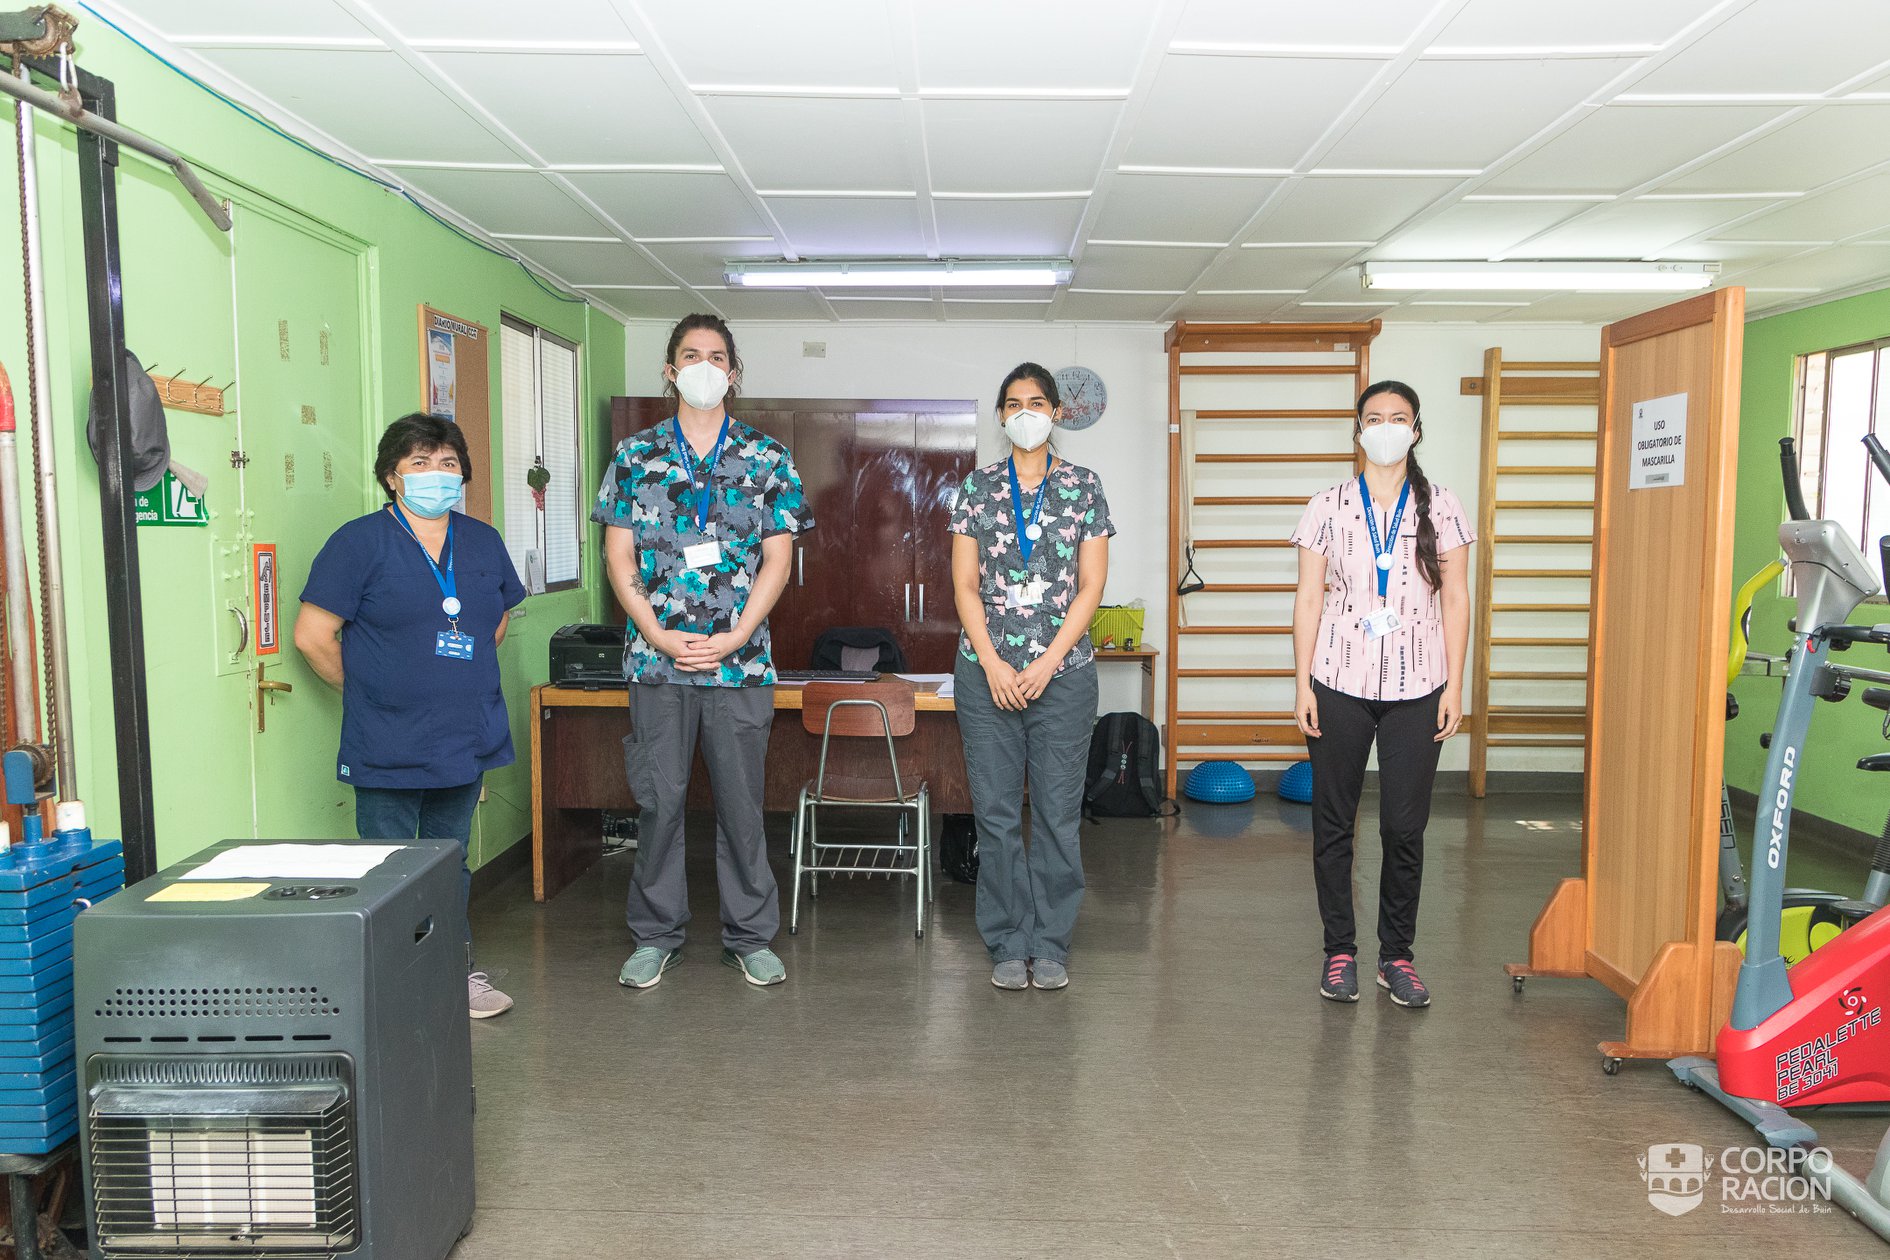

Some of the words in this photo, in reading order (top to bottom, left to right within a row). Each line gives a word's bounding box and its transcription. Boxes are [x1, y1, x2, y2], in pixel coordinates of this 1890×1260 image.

[1653, 420, 1666, 431] USO
[1637, 436, 1673, 451] OBLIGATORIO
[1674, 434, 1682, 446] DE
[1641, 453, 1675, 467] MASCARILLA
[138, 495, 149, 507] de
[1767, 746, 1796, 869] OXFORD
[1776, 1007, 1881, 1071] PEDALETTE
[1777, 1049, 1838, 1088] PEARL
[1777, 1080, 1800, 1102] BE
[1802, 1063, 1839, 1091] 3041
